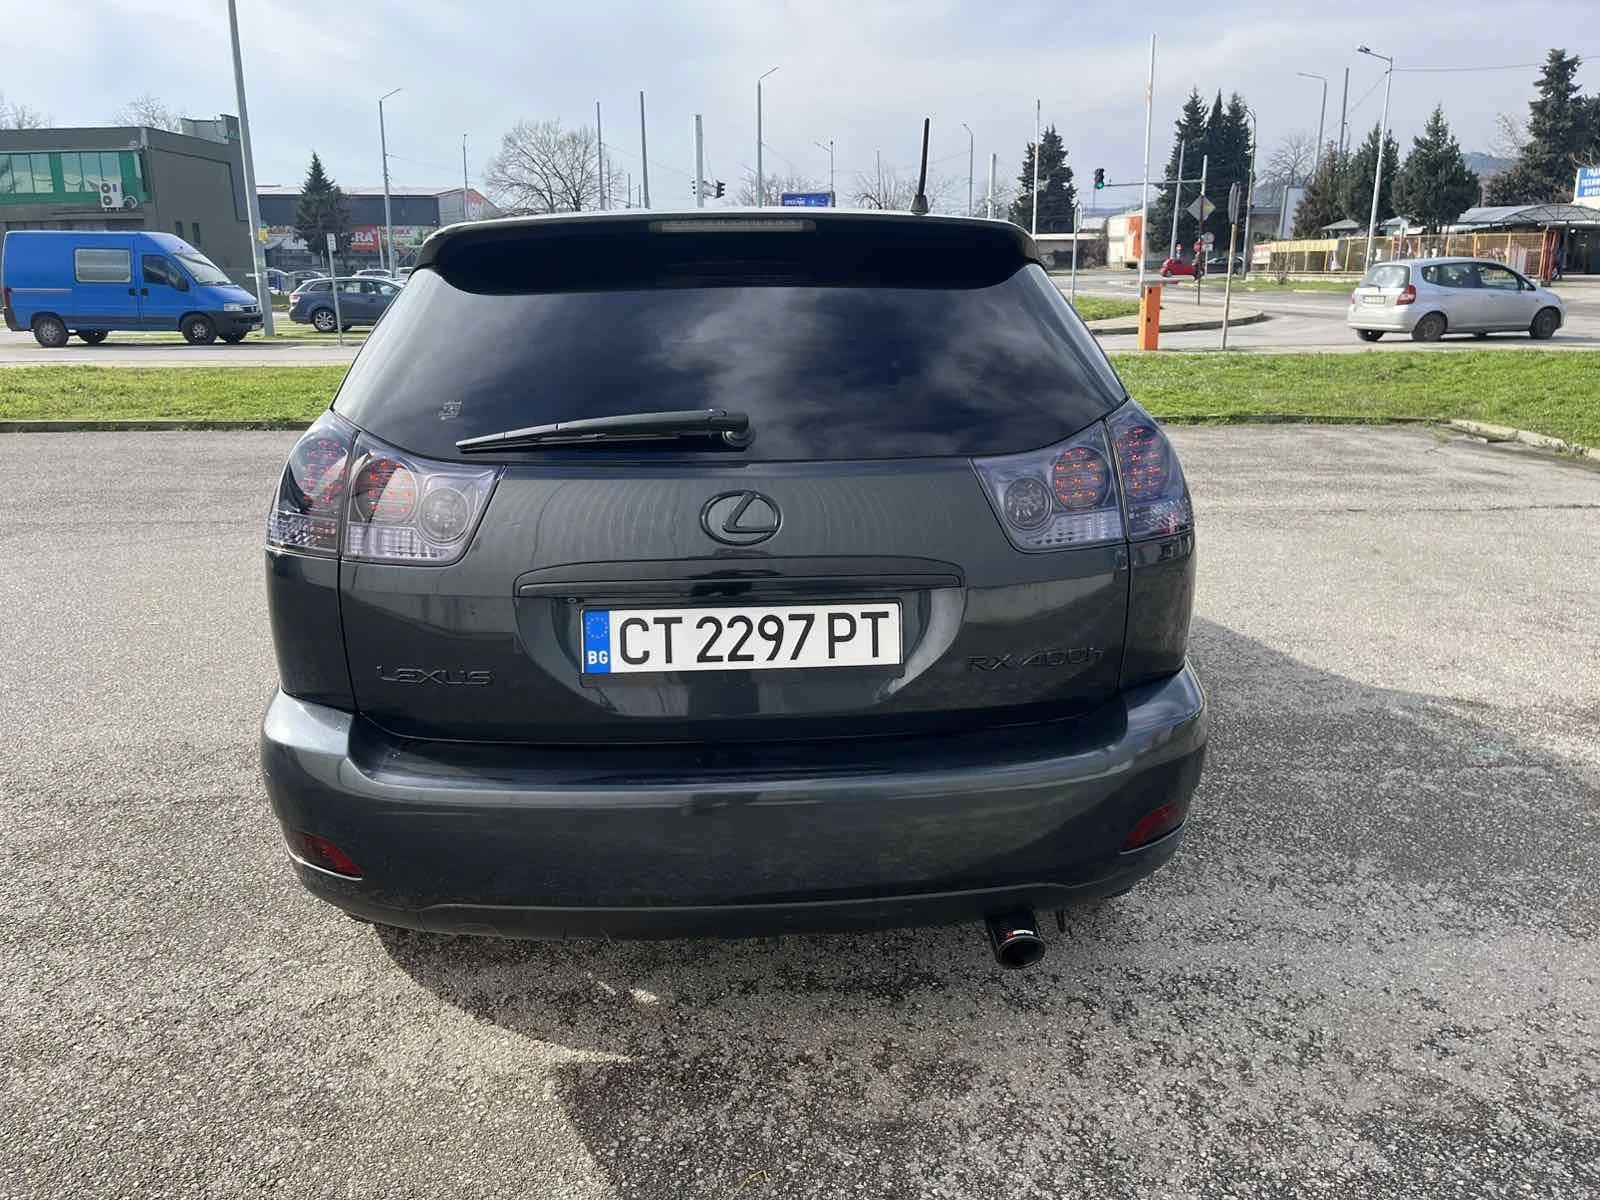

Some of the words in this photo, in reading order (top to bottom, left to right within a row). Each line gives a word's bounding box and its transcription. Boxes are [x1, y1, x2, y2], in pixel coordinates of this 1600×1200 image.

[620, 616, 683, 665] CT
[695, 613, 815, 663] 2297
[827, 610, 890, 659] PT
[587, 651, 608, 665] BG
[966, 654, 1012, 671] RX
[375, 665, 493, 686] LEXUS
